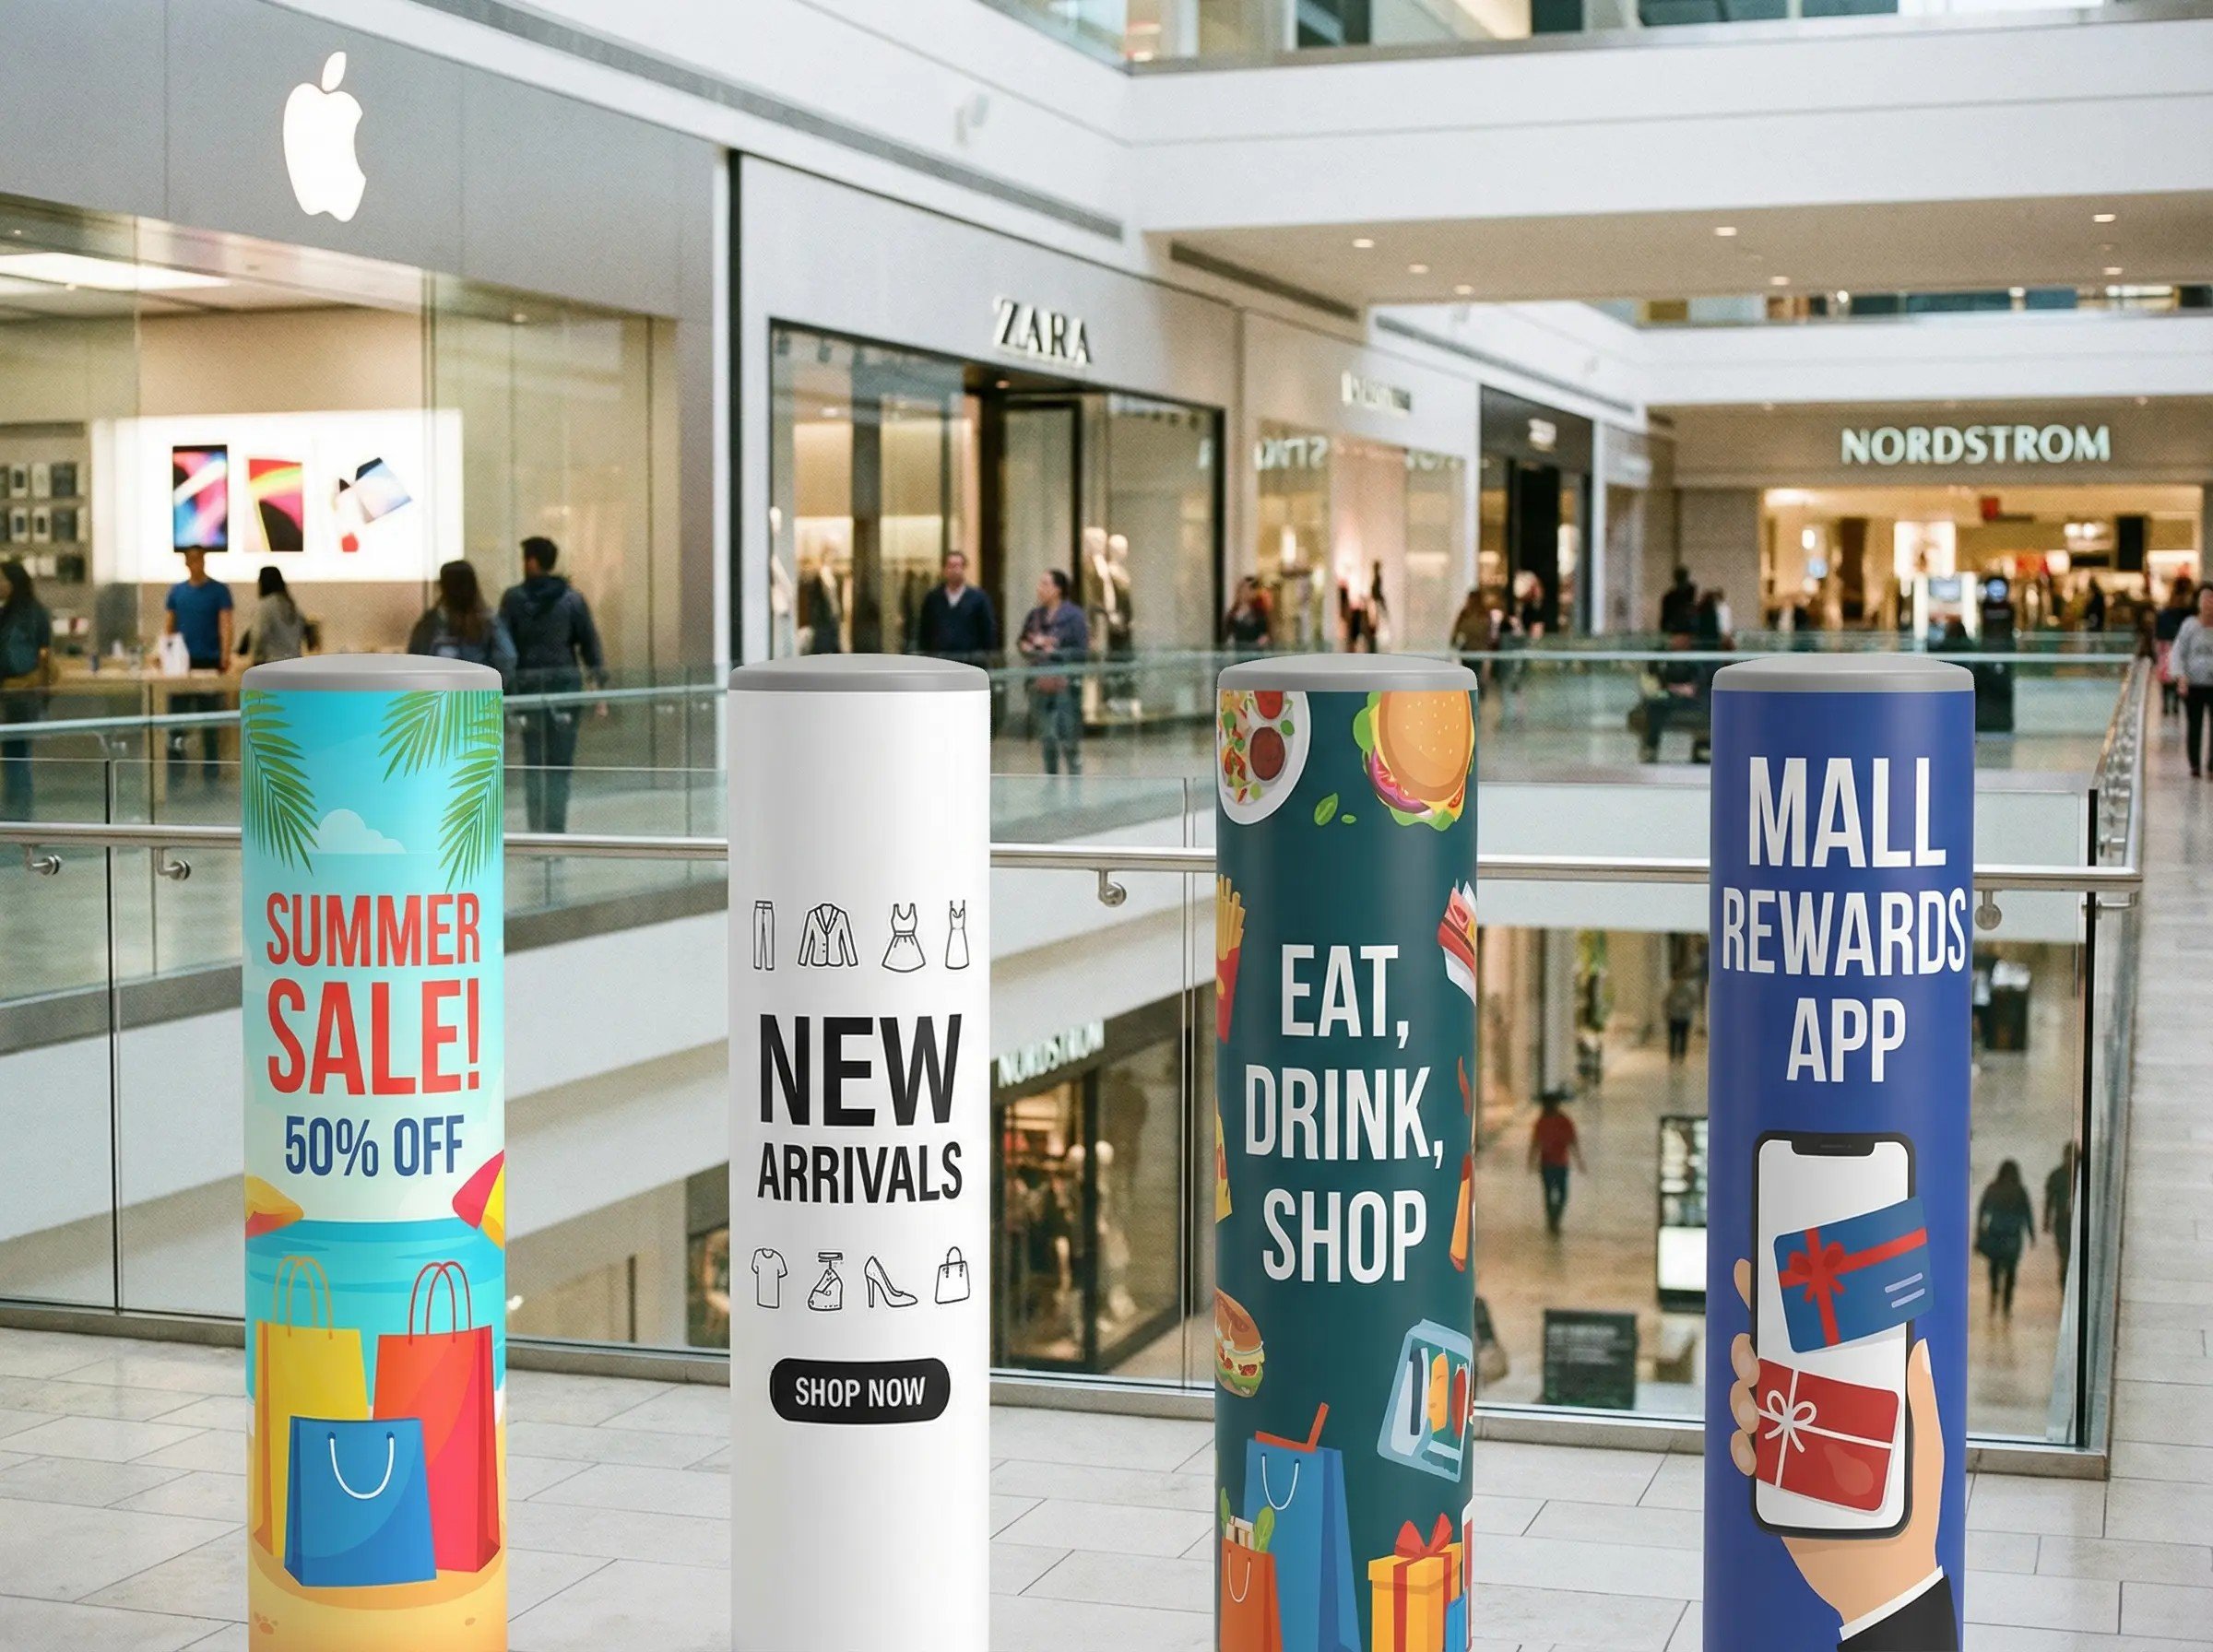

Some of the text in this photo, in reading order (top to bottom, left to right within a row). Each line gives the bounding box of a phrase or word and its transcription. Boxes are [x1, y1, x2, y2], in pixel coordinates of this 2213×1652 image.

[992, 296, 1092, 367] ZARA
[1840, 424, 2112, 466] NORDSTROM
[1749, 756, 1947, 867] MALL
[266, 892, 479, 966] SUMMER
[1722, 886, 1966, 976] REWARDS
[267, 978, 479, 1095] SALE!
[1281, 944, 1409, 1049] EAT,
[1786, 997, 1906, 1082] APP
[760, 1013, 962, 1127] NEW
[285, 1114, 465, 1177] 50% OFF
[1245, 1064, 1444, 1169] DRINK,
[757, 1141, 962, 1204] ARRIVALS
[1262, 1188, 1427, 1283] SHOP
[795, 1376, 926, 1408] SHOP NOW
